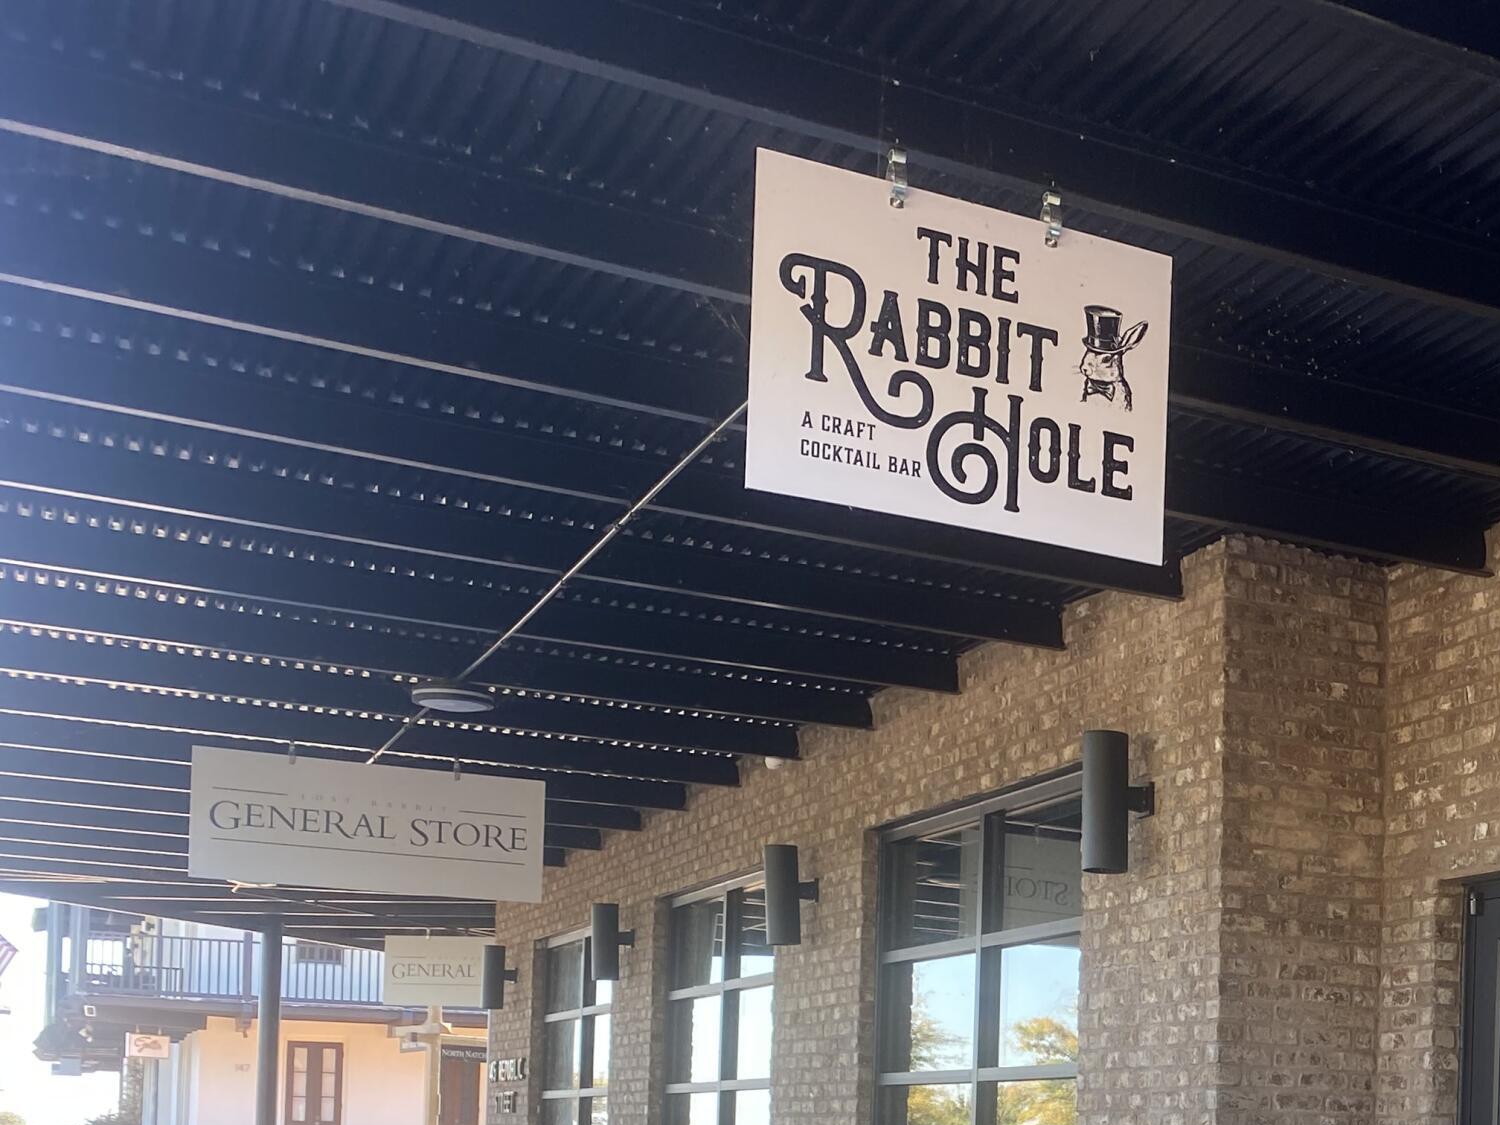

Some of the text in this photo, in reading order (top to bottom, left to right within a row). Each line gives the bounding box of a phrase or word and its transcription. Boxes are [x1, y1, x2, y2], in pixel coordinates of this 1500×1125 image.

[917, 226, 1021, 303] THE
[779, 252, 1059, 430] RABBIT
[801, 411, 876, 441] A CRAFT
[926, 386, 1135, 513] HOLE
[800, 438, 922, 479] COCKTAIL BAR
[209, 800, 528, 853] GENERAL STORE
[391, 962, 475, 980] GENERAL
